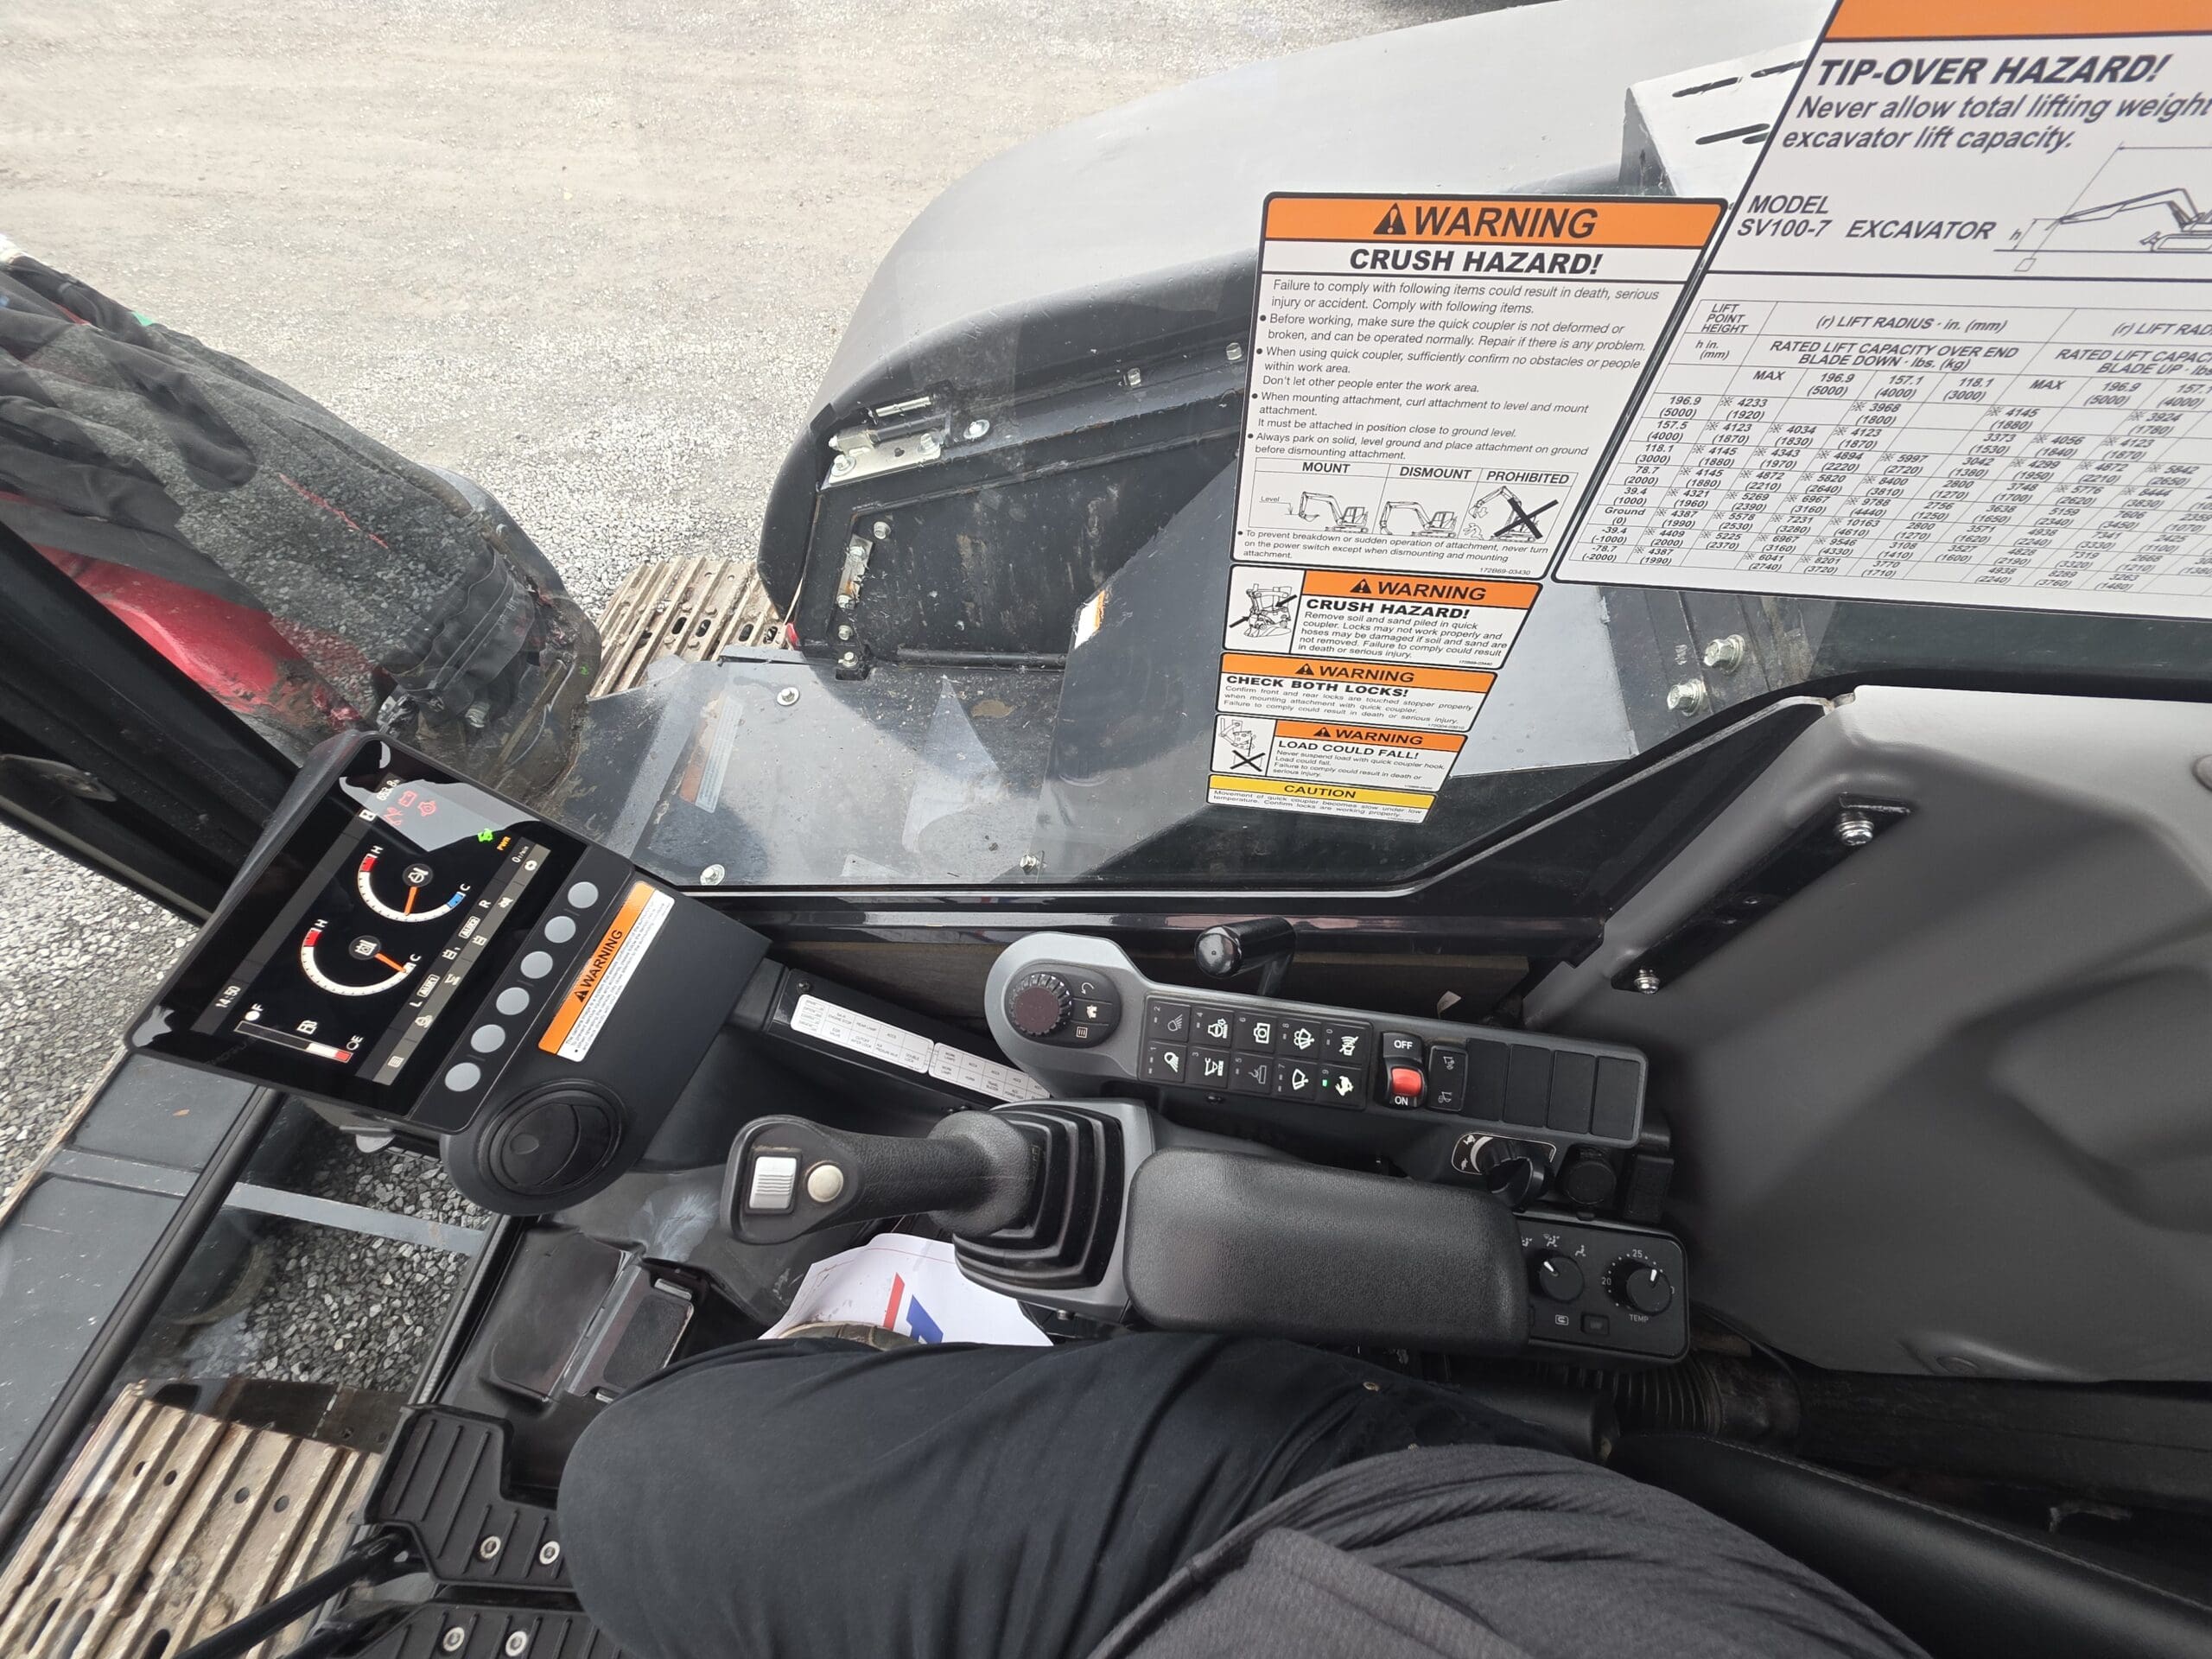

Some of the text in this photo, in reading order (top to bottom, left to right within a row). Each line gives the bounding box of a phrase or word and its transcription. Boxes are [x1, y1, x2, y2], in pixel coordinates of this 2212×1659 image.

[1818, 54, 2174, 86] TIP-OVER HAZARD!
[1796, 96, 1878, 118] Never
[1880, 95, 1957, 118] allow
[1958, 94, 2028, 118] total
[2025, 93, 2113, 122] lifting
[1783, 125, 2075, 153] excavator lift capacity.
[1747, 195, 1828, 214] MODEL
[1416, 207, 1599, 238] WARNING
[1738, 219, 1997, 239] SV100-7 EXCAVATOR
[1351, 249, 1604, 275] CRUSH HAZARD!
[1274, 279, 1660, 301] Failure to comply with following items could result in death, serious
[1272, 296, 1534, 315] injury or accident. Comply with following items.
[1711, 304, 1740, 314] LIFT
[1270, 313, 1305, 324] Before
[1308, 315, 1353, 328] working,
[1357, 316, 1388, 327] make
[1418, 318, 1435, 328] the
[1439, 318, 1470, 331] quick
[1472, 320, 1516, 333] coupler
[1517, 321, 1528, 331] is
[1530, 321, 1550, 332] not
[1553, 321, 1611, 334] deformed
[1611, 326, 1625, 334] or
[1706, 314, 1746, 323] POINT
[1816, 315, 2008, 334] (r) LIFT RADIUS in. (mm)
[1701, 324, 1748, 334] HEIGHT
[1268, 329, 1307, 341] broken,
[1311, 331, 1332, 340] and
[1357, 332, 1371, 342] be
[1374, 334, 1424, 345] operated
[1426, 335, 1474, 347] normally.
[1478, 335, 1516, 348] Repair
[1517, 337, 1527, 346] if
[1528, 337, 1557, 348] there
[1560, 338, 1570, 348] is
[1572, 340, 1594, 352] any
[1595, 340, 1645, 352] problem.
[1695, 340, 1719, 349] h in.
[1700, 350, 1730, 361] (mm)
[1770, 340, 2019, 358] RATED LIFT CAPACITY OVER END
[1267, 346, 1296, 357] When
[1300, 347, 1327, 360] using
[1331, 349, 1359, 360] quick
[1362, 350, 1403, 362] coupler,
[1408, 351, 1465, 365] sufficiently
[1468, 353, 1510, 364] confirm
[1529, 356, 1584, 366] obstacles
[1600, 359, 1641, 371] people
[1798, 354, 1971, 372] BLADE DOWN lbs. (kg)
[1265, 361, 1294, 371] within
[1298, 363, 1323, 372] work
[1753, 371, 1786, 380] MAX
[1821, 373, 1855, 383] 196.9
[1889, 375, 1924, 385] 157.1
[1263, 375, 1290, 385] Don't
[1294, 377, 1306, 386] let
[1308, 378, 1336, 387] other
[1338, 378, 1373, 390] people
[1376, 380, 1403, 389] enter
[1406, 380, 1422, 391] the
[1426, 382, 1452, 391] work
[1807, 385, 1848, 397] (5000)
[1874, 388, 1917, 400] (4000)
[1262, 392, 1589, 413] When mounting attachment, curl attachment to level and mount
[1260, 406, 1317, 416] attachment.
[1302, 462, 1351, 474] MOUNT
[1400, 467, 1472, 480] DISMOUNT
[1486, 471, 1569, 484] PROHIBITED
[1379, 582, 1486, 601] WARNING
[1306, 600, 1470, 619] CRUSH HAZARD!
[1320, 666, 1414, 683] WARNING
[1227, 676, 1408, 697] CHECK BOTH LOCKS!
[1336, 729, 1423, 745] WARNING
[1279, 741, 1419, 760] LOAD COULD FALL!
[1284, 785, 1357, 798] CAUTION
[370, 845, 384, 855] H
[496, 836, 511, 850] PWR
[460, 883, 471, 892] C
[315, 919, 329, 928] H
[581, 929, 623, 988] WARNING
[216, 985, 241, 1008] 14:50
[254, 1003, 264, 1013] F
[353, 1035, 364, 1046] E
[1394, 1040, 1413, 1050] OFF
[1395, 1096, 1408, 1106] ON
[1633, 1249, 1642, 1258] 25
[1630, 1313, 1649, 1322] TEMP
